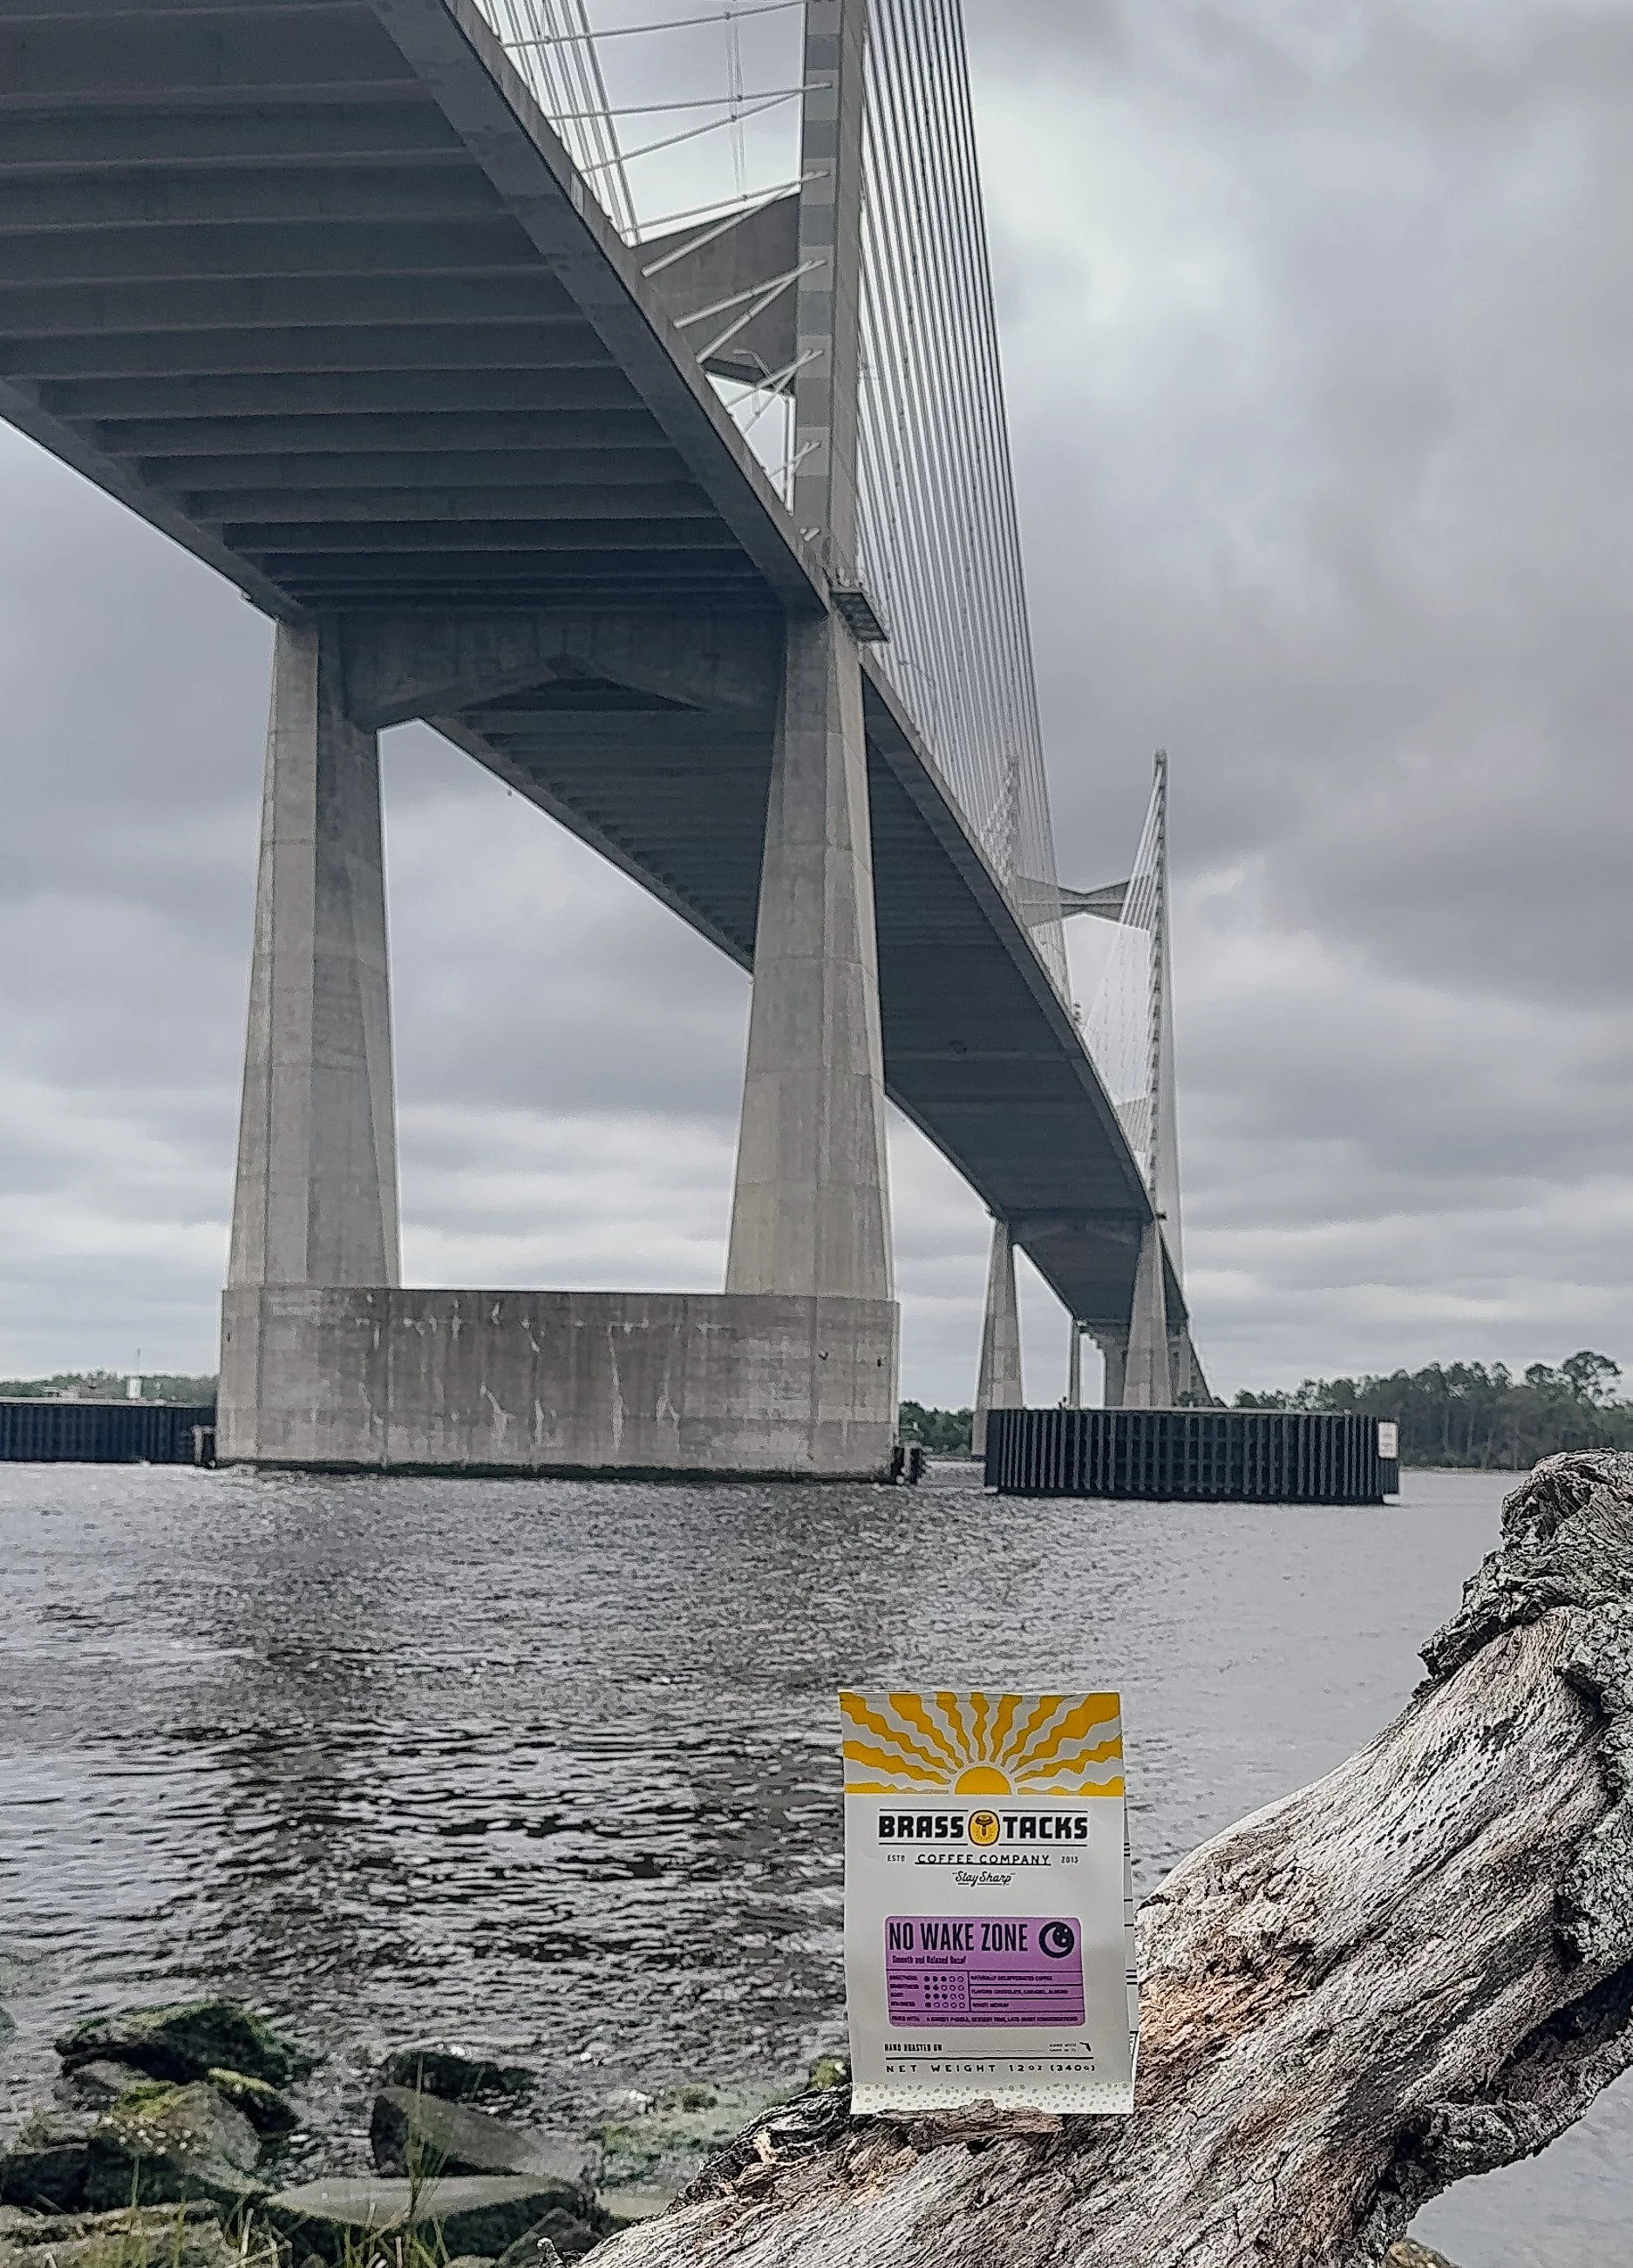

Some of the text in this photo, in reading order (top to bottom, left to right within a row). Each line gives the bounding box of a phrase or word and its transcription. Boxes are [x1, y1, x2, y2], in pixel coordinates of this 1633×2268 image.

[879, 1816, 1087, 1839] BRASS TACKS
[917, 1854, 974, 1864] COFFEE
[979, 1854, 1050, 1865] COMPANY
[889, 1923, 1028, 1952] NO WAKE ZONE
[884, 2043, 902, 2052] HAND
[903, 2043, 931, 2052] ROASTED
[886, 2064, 916, 2073] NET
[930, 2064, 996, 2073] WEIGHT
